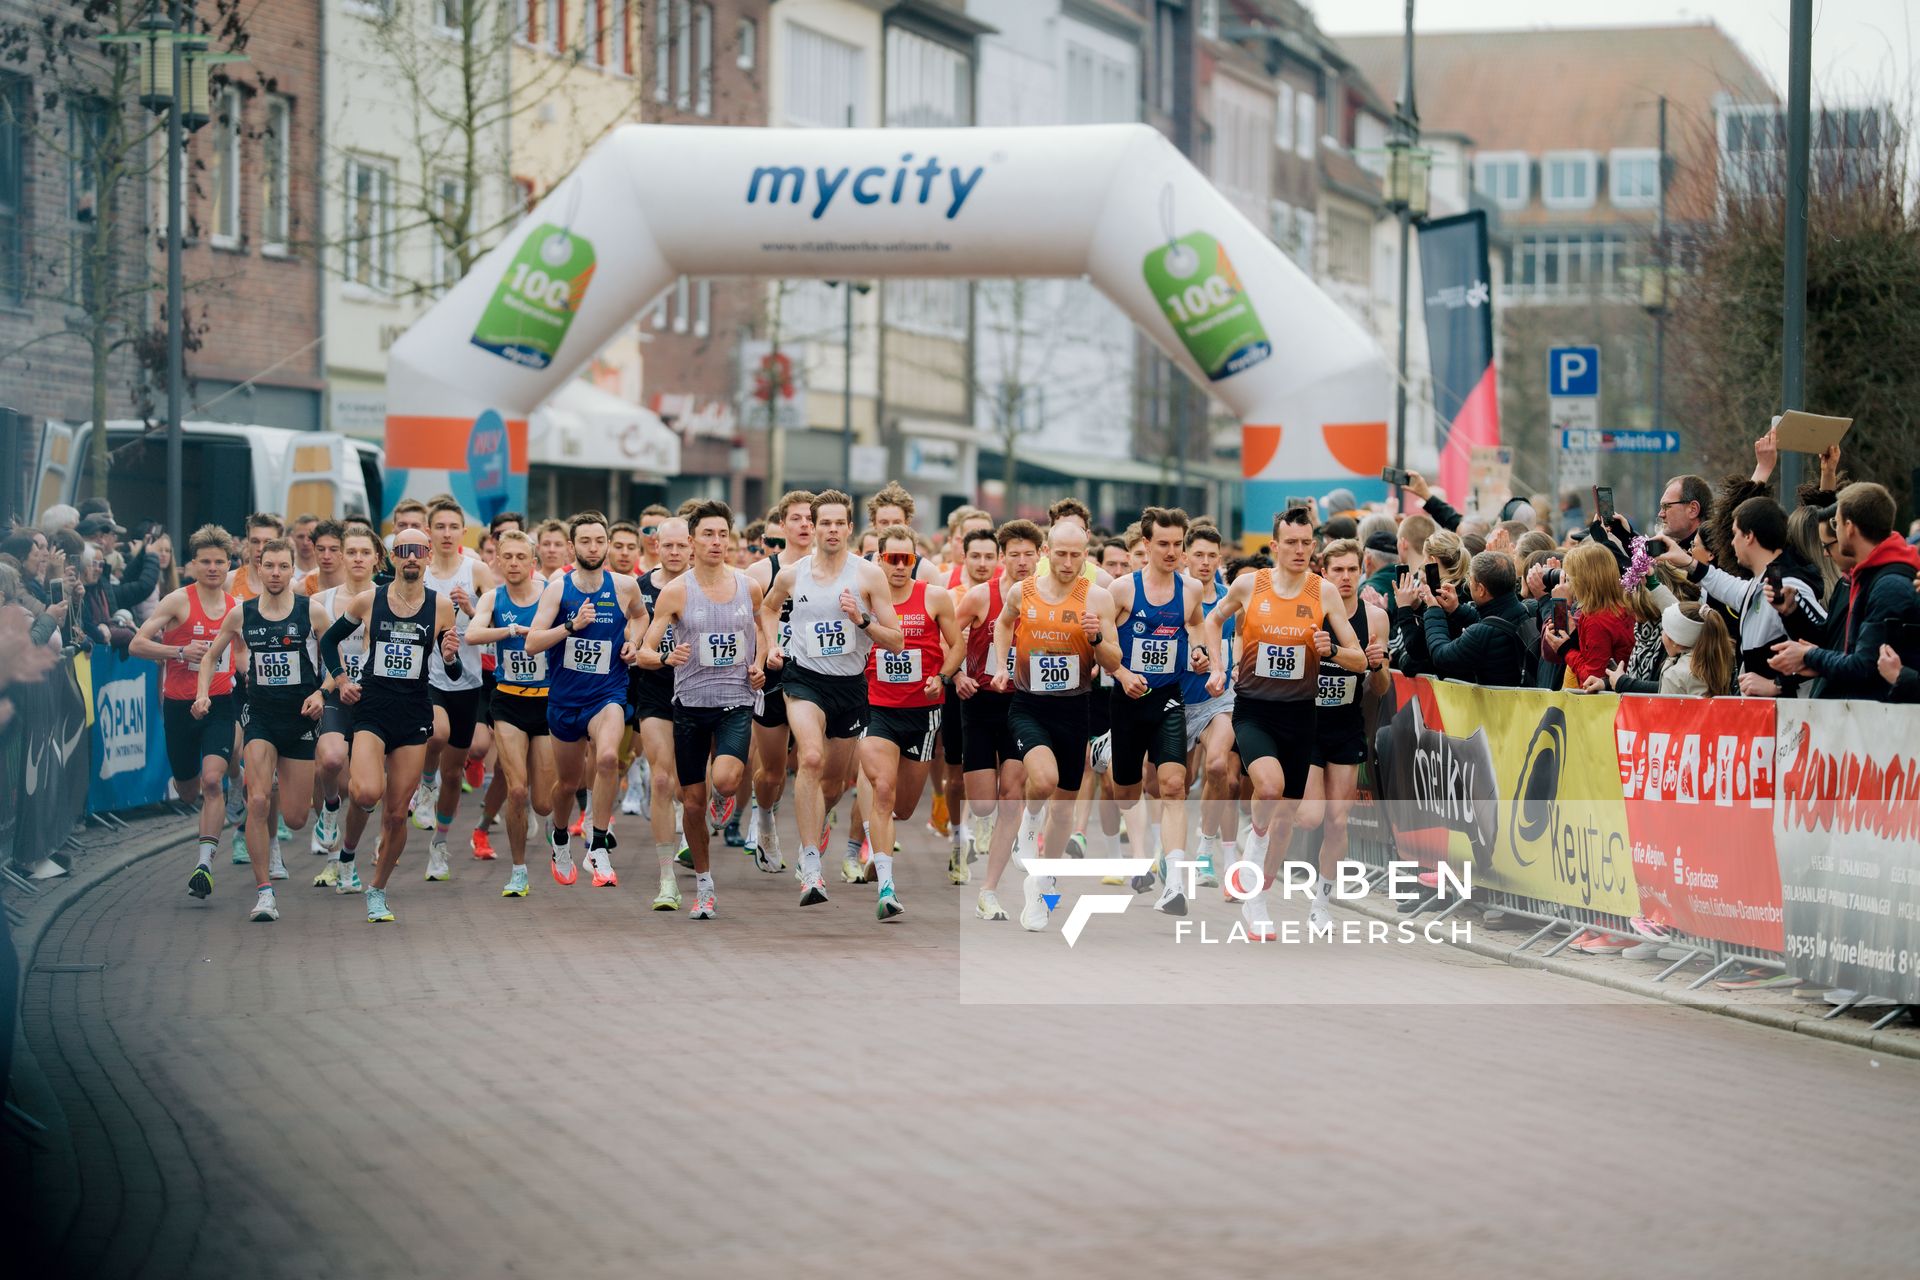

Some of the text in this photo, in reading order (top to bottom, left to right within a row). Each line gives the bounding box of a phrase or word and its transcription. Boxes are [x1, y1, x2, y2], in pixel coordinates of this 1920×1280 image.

[747, 153, 984, 219] mycity
[1560, 353, 1588, 392] P
[814, 621, 843, 633] GLS
[1262, 624, 1306, 637] VIACTIV
[708, 634, 736, 645] GLS
[817, 632, 845, 647] 178
[1031, 630, 1071, 640] VIACTIV
[384, 644, 412, 656] GLS
[574, 640, 601, 651] GLS
[711, 645, 736, 657] 175
[1141, 641, 1168, 651] GLS
[1267, 645, 1295, 657] GLS
[262, 653, 288, 664] GLS
[384, 655, 412, 670] 656
[574, 650, 602, 664] 927
[1039, 657, 1068, 668] GLS
[1141, 651, 1168, 665] 985
[512, 661, 536, 673] 910
[885, 662, 912, 674] 898
[1267, 657, 1295, 671] 198
[1040, 668, 1069, 682] 200
[1319, 677, 1346, 687] GLS
[1319, 687, 1346, 699] 935
[115, 696, 144, 737] PLAN
[1633, 841, 1645, 863] die
[1685, 866, 1718, 891] Sparkasse
[1898, 950, 1908, 974] 8
